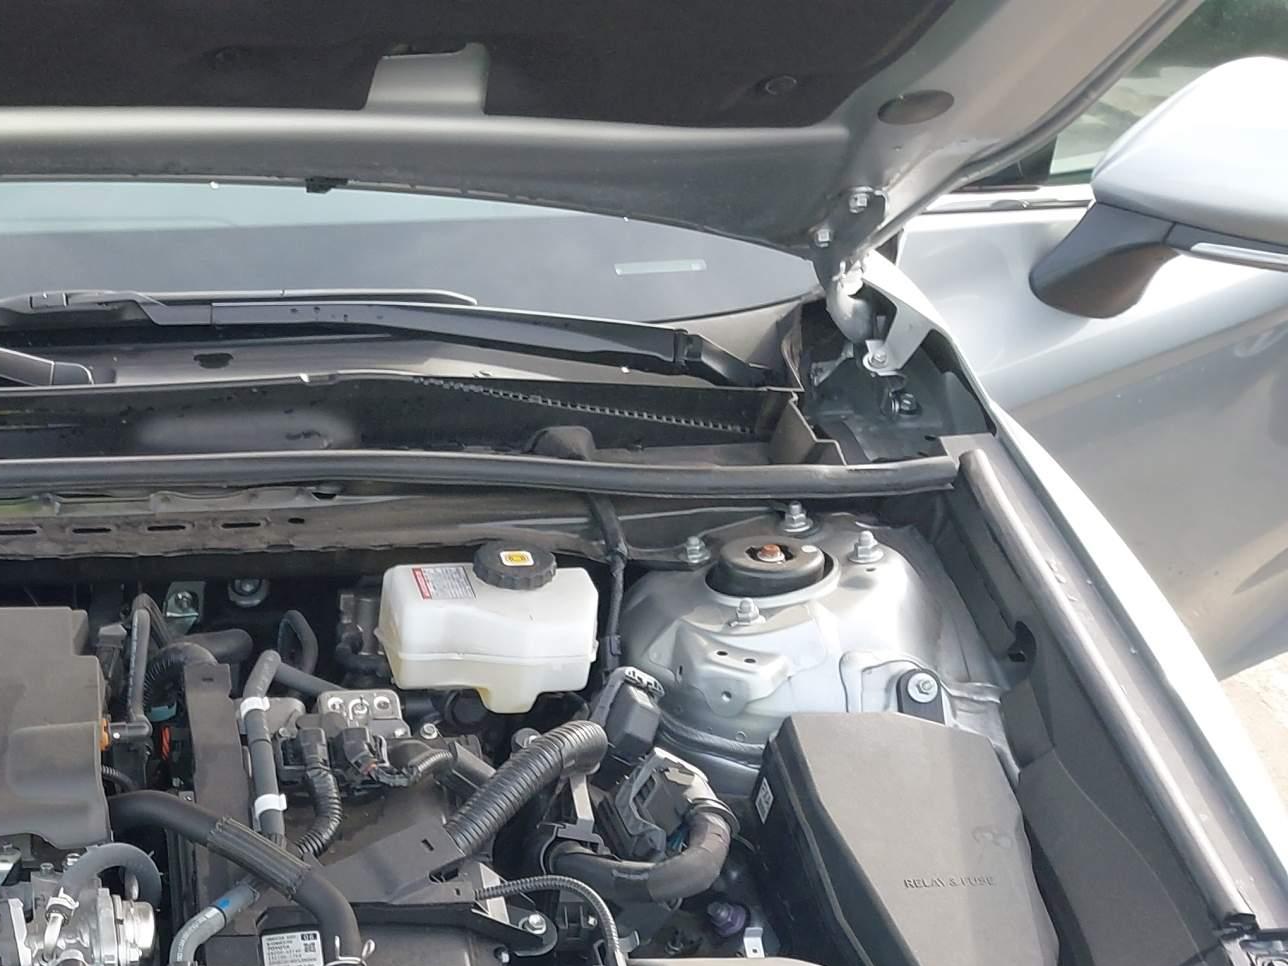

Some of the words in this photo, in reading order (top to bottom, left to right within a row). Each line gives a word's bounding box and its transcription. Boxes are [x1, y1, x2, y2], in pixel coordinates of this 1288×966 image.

[903, 878, 945, 889] RELAY
[949, 878, 959, 888] &
[960, 877, 996, 888] FUSE
